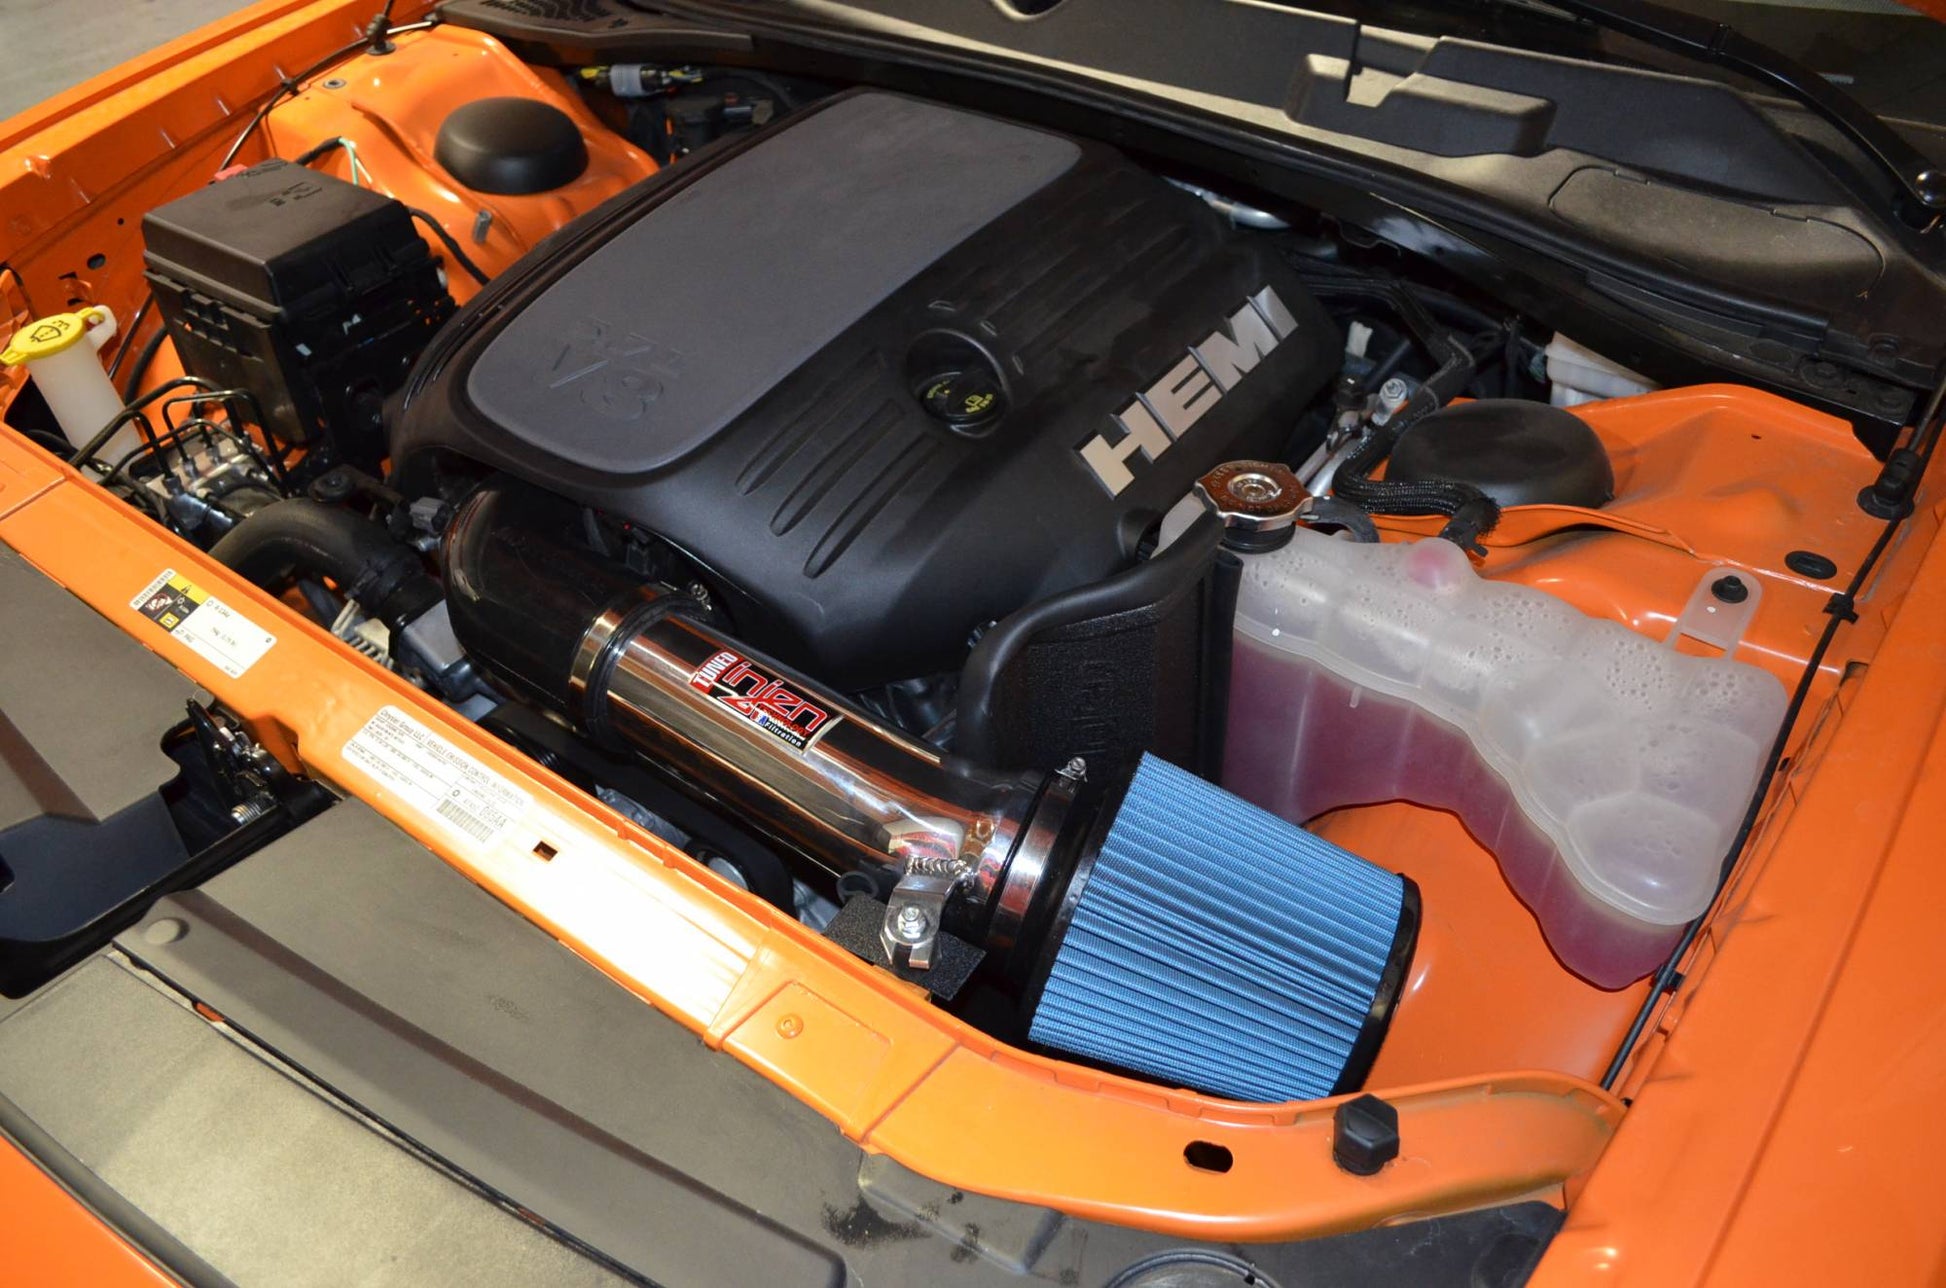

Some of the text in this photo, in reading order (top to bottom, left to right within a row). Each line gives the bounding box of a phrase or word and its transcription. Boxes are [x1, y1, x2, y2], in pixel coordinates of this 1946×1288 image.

[1075, 285, 1298, 499] HEMI
[693, 652, 738, 687] TUNED
[718, 662, 828, 732] injen
[764, 720, 802, 747] Filtration
